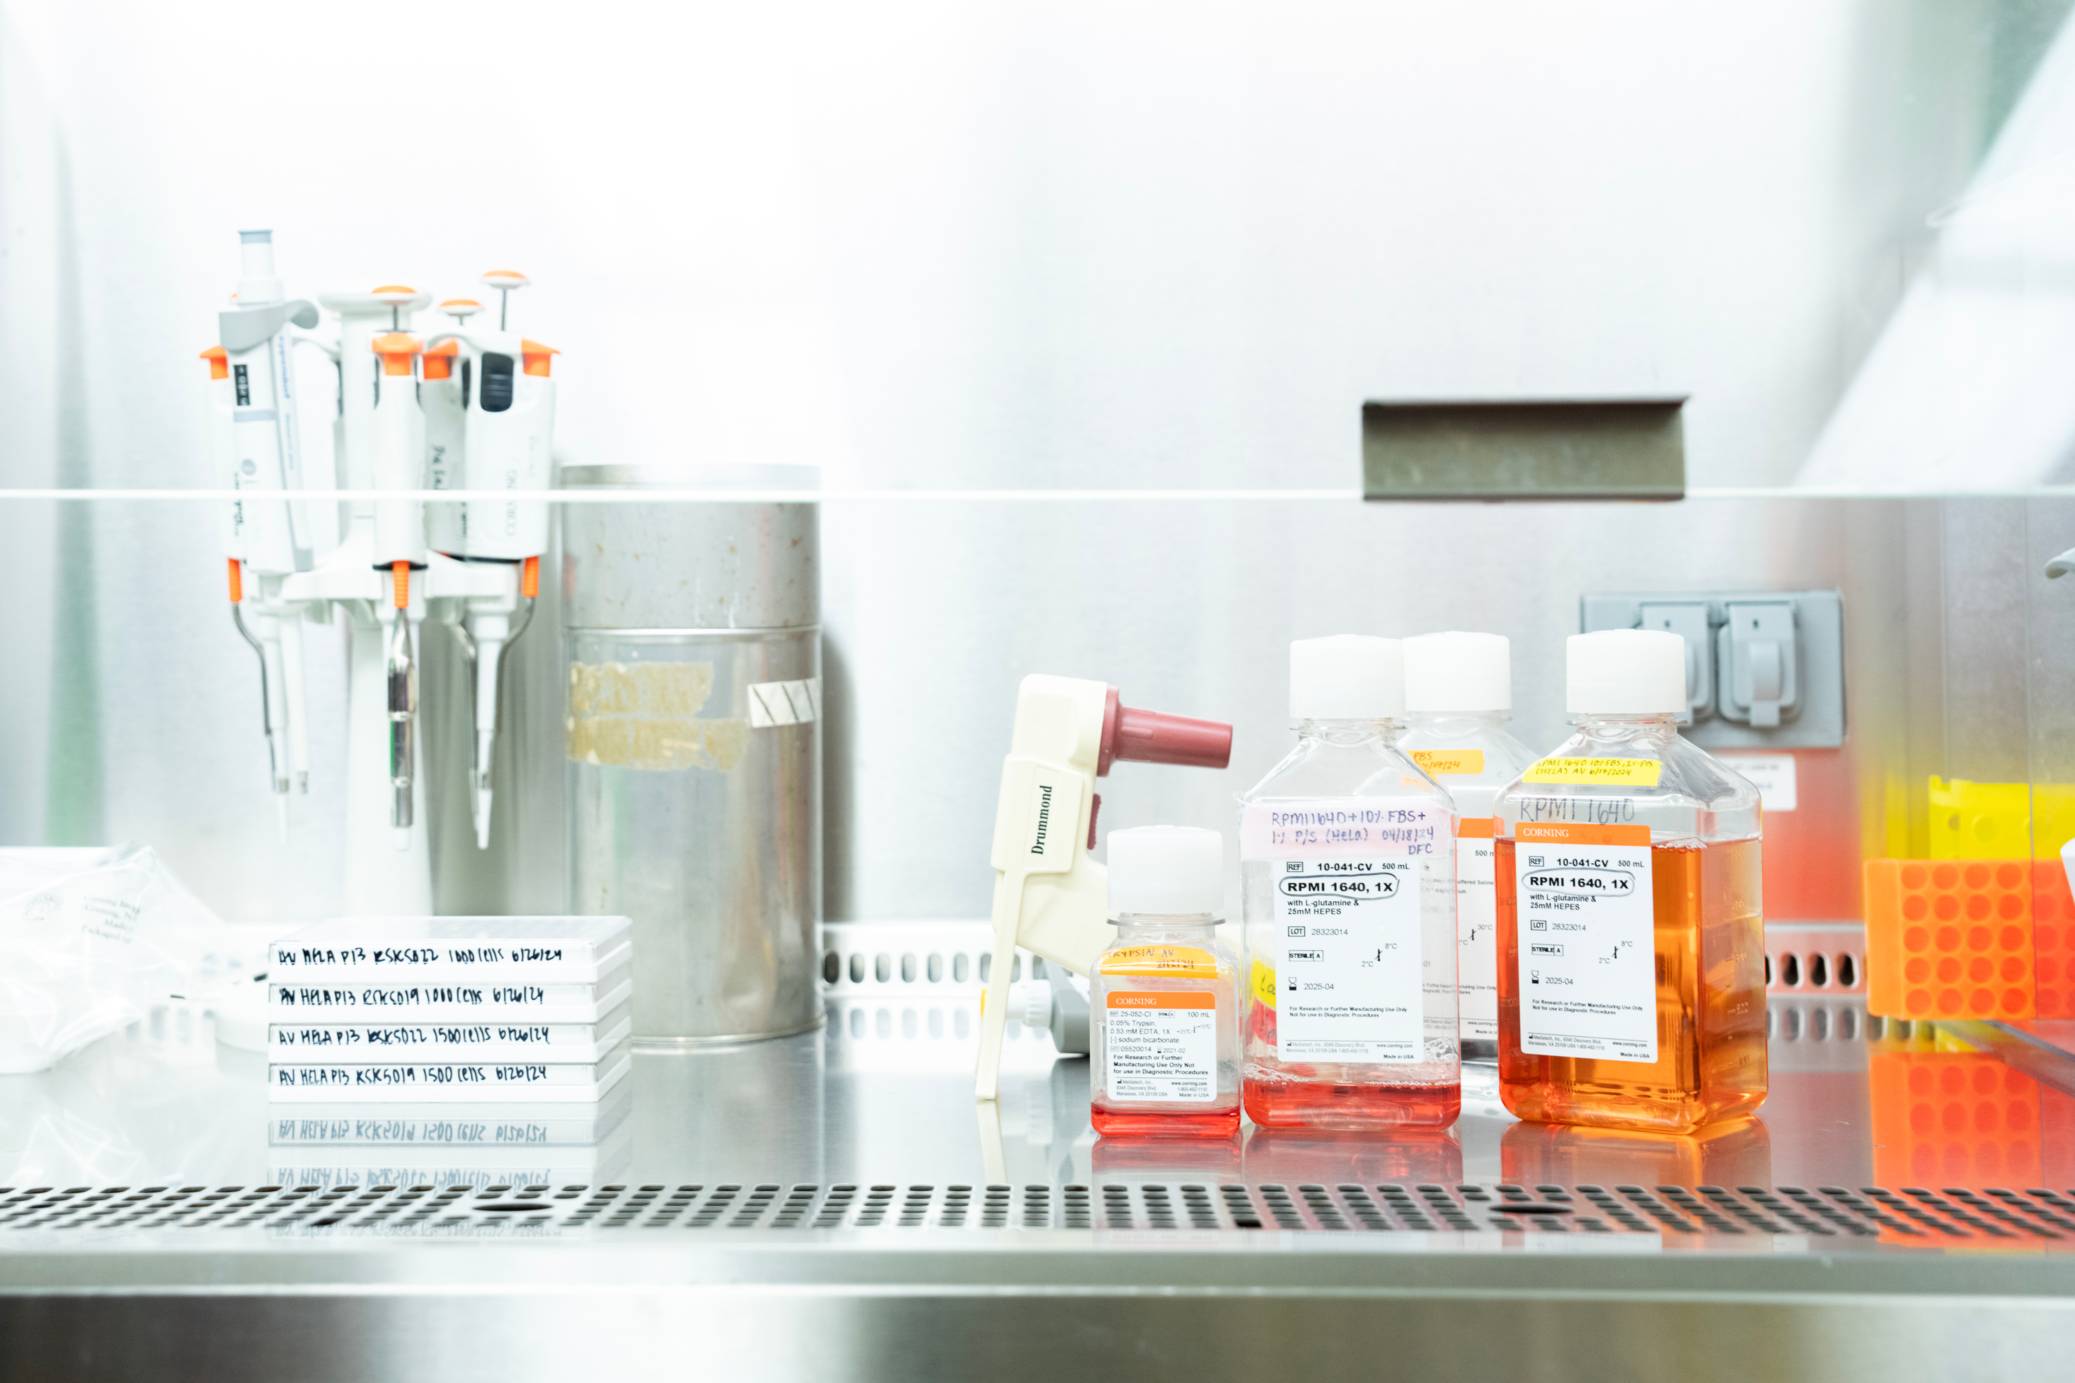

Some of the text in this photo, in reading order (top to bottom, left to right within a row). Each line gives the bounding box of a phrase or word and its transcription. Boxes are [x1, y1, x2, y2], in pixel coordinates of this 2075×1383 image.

[1521, 798, 1635, 825] RPMI 1640
[1031, 785, 1052, 855] Drummond
[1523, 827, 1569, 837] CORNING
[1408, 844, 1433, 856] DFC
[1317, 863, 1373, 871] 10-041-CV
[1557, 858, 1609, 868] 10-041-CV
[1287, 882, 1393, 894] RPMI 1640, 1X
[1530, 876, 1629, 890] RPMI 1640, 1X
[1305, 900, 1352, 908] L-glutamine
[1546, 895, 1589, 904] L-glutamine
[1554, 903, 1580, 911] HEPES
[1115, 997, 1157, 1005] CORNING
